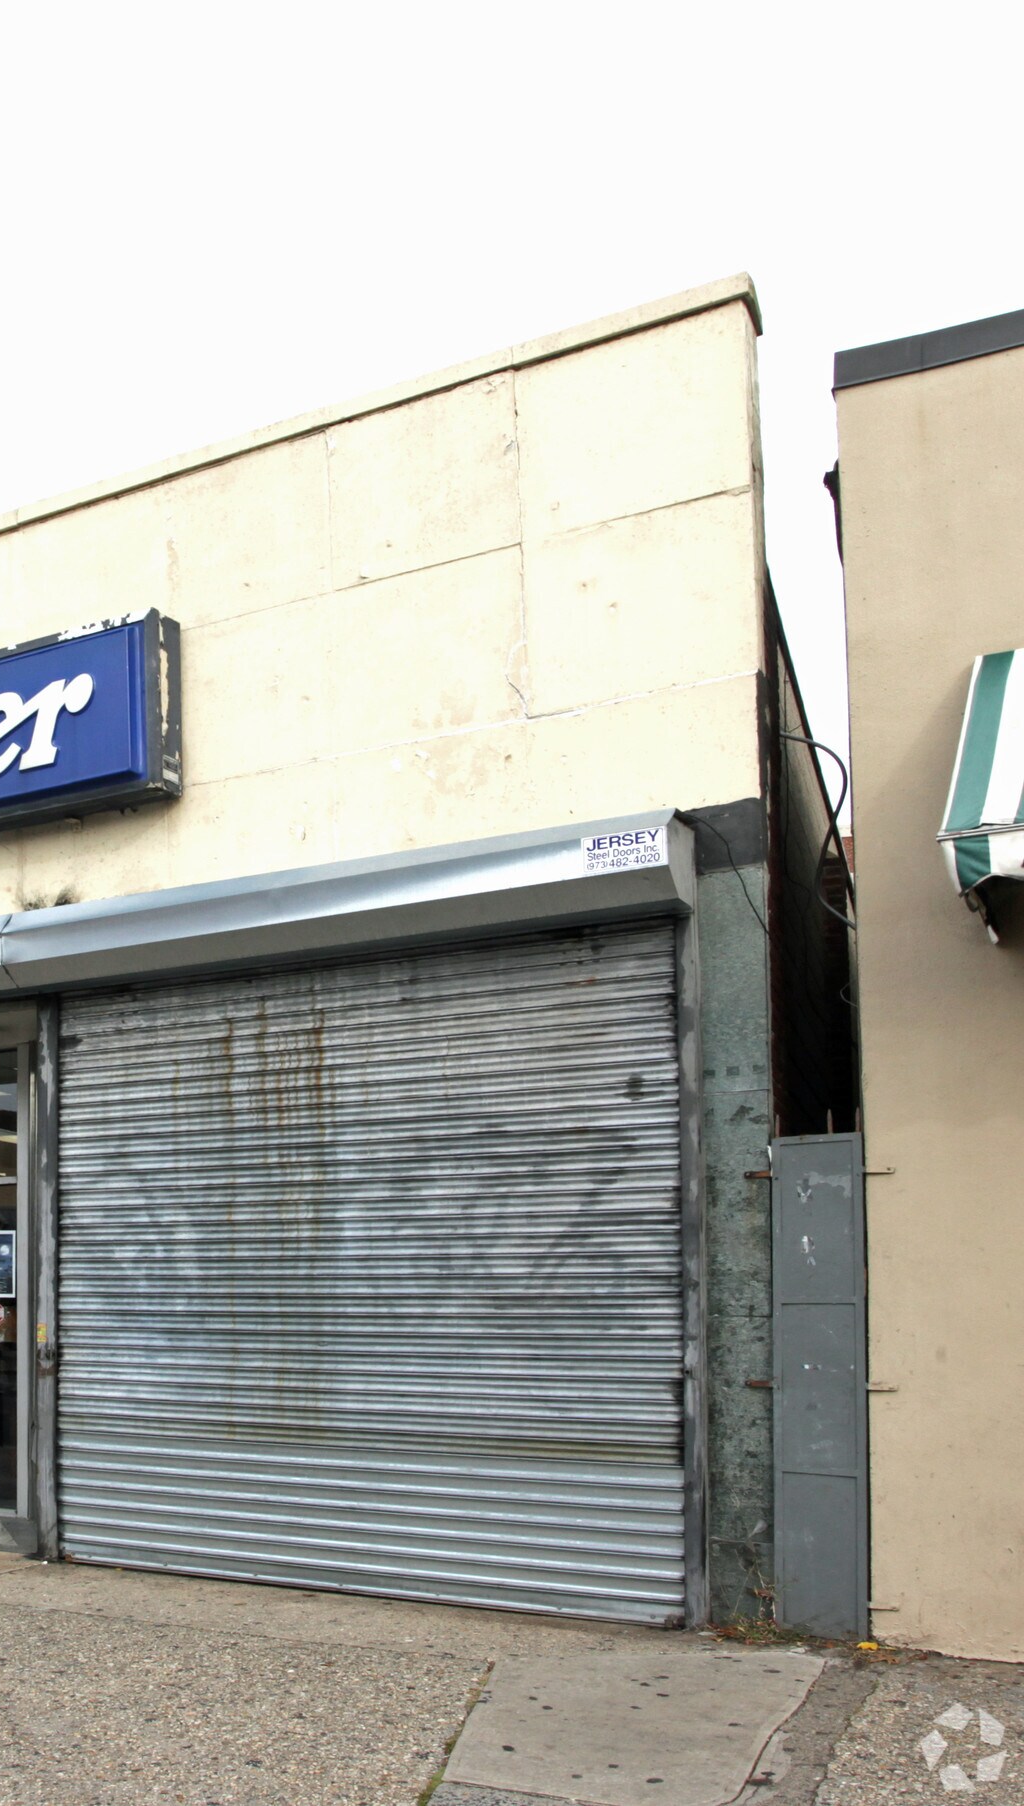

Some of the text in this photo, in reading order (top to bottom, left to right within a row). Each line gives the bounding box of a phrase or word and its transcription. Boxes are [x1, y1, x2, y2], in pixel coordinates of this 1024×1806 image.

[586, 829, 660, 852] JERSEY
[587, 844, 660, 862] Steel Doors Inc.
